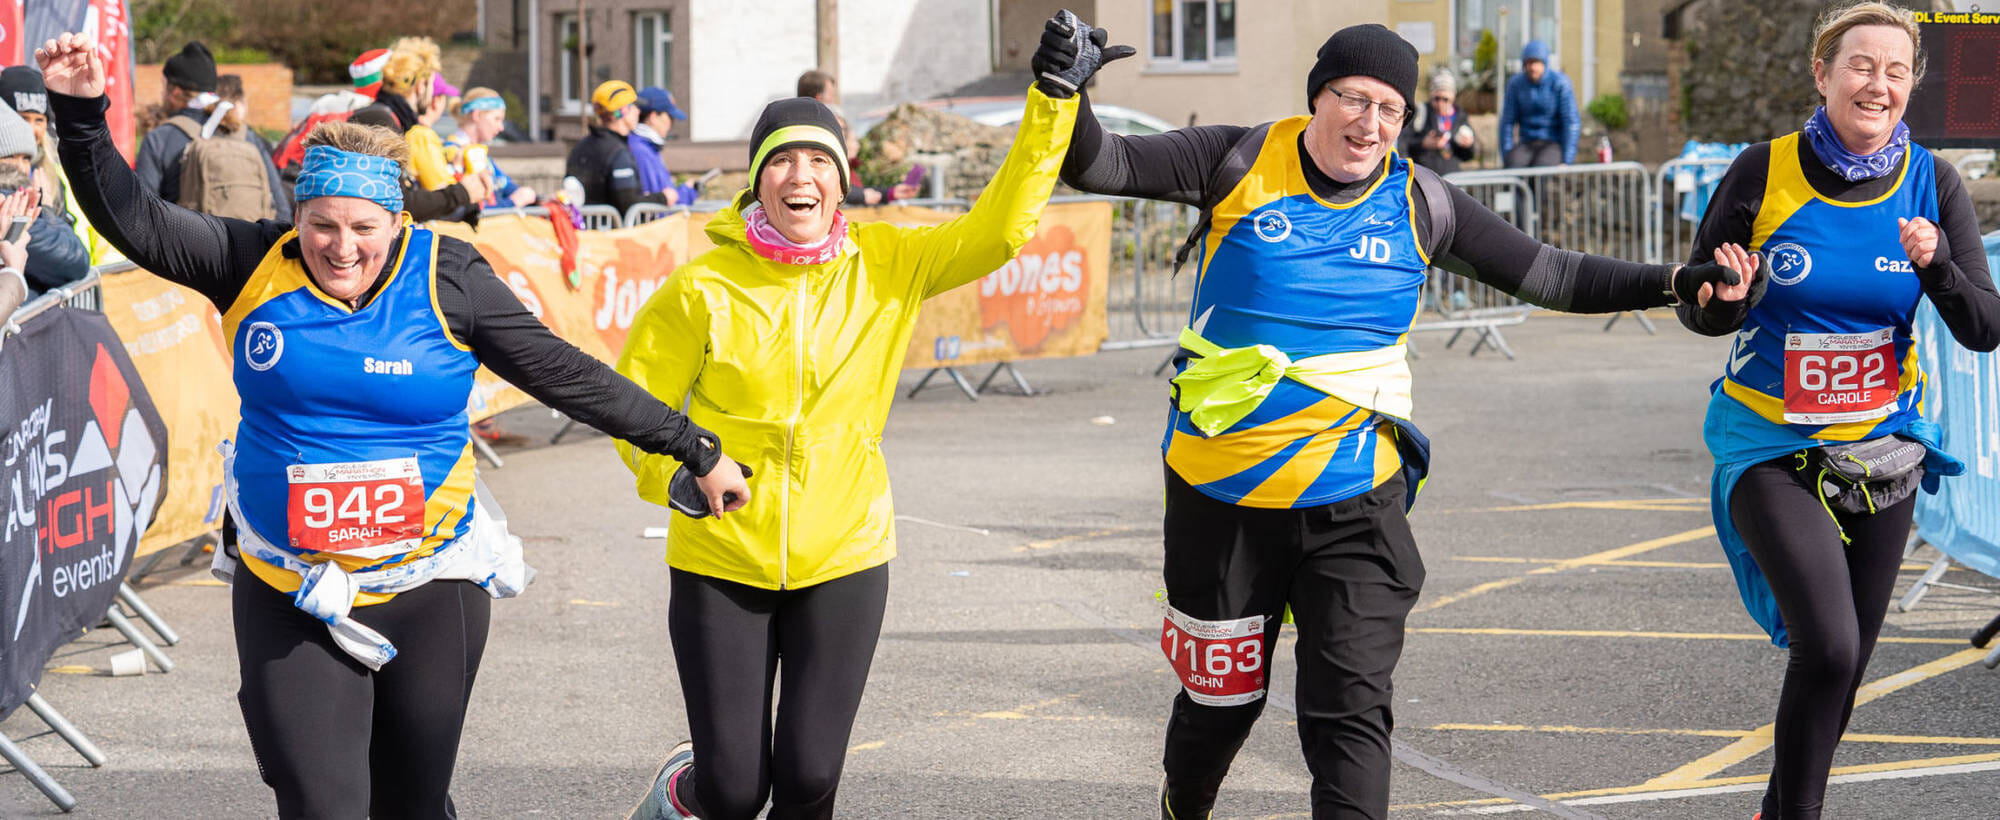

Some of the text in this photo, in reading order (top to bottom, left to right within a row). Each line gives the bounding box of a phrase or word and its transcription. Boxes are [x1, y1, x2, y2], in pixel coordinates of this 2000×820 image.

[1914, 12, 1932, 23] DL
[1934, 12, 1970, 24] Event
[1350, 235, 1391, 263] JD
[1875, 257, 1915, 273] Caz
[596, 266, 668, 330] Jon
[364, 357, 413, 375] Sarah
[1800, 352, 1885, 391] 622
[1818, 391, 1872, 405] CAROLE
[304, 484, 405, 529] 942
[37, 480, 114, 564] HIGH
[328, 526, 382, 543] SARAH
[52, 544, 113, 597] events
[1166, 627, 1262, 676] 1163
[1189, 673, 1223, 688] JOHN
